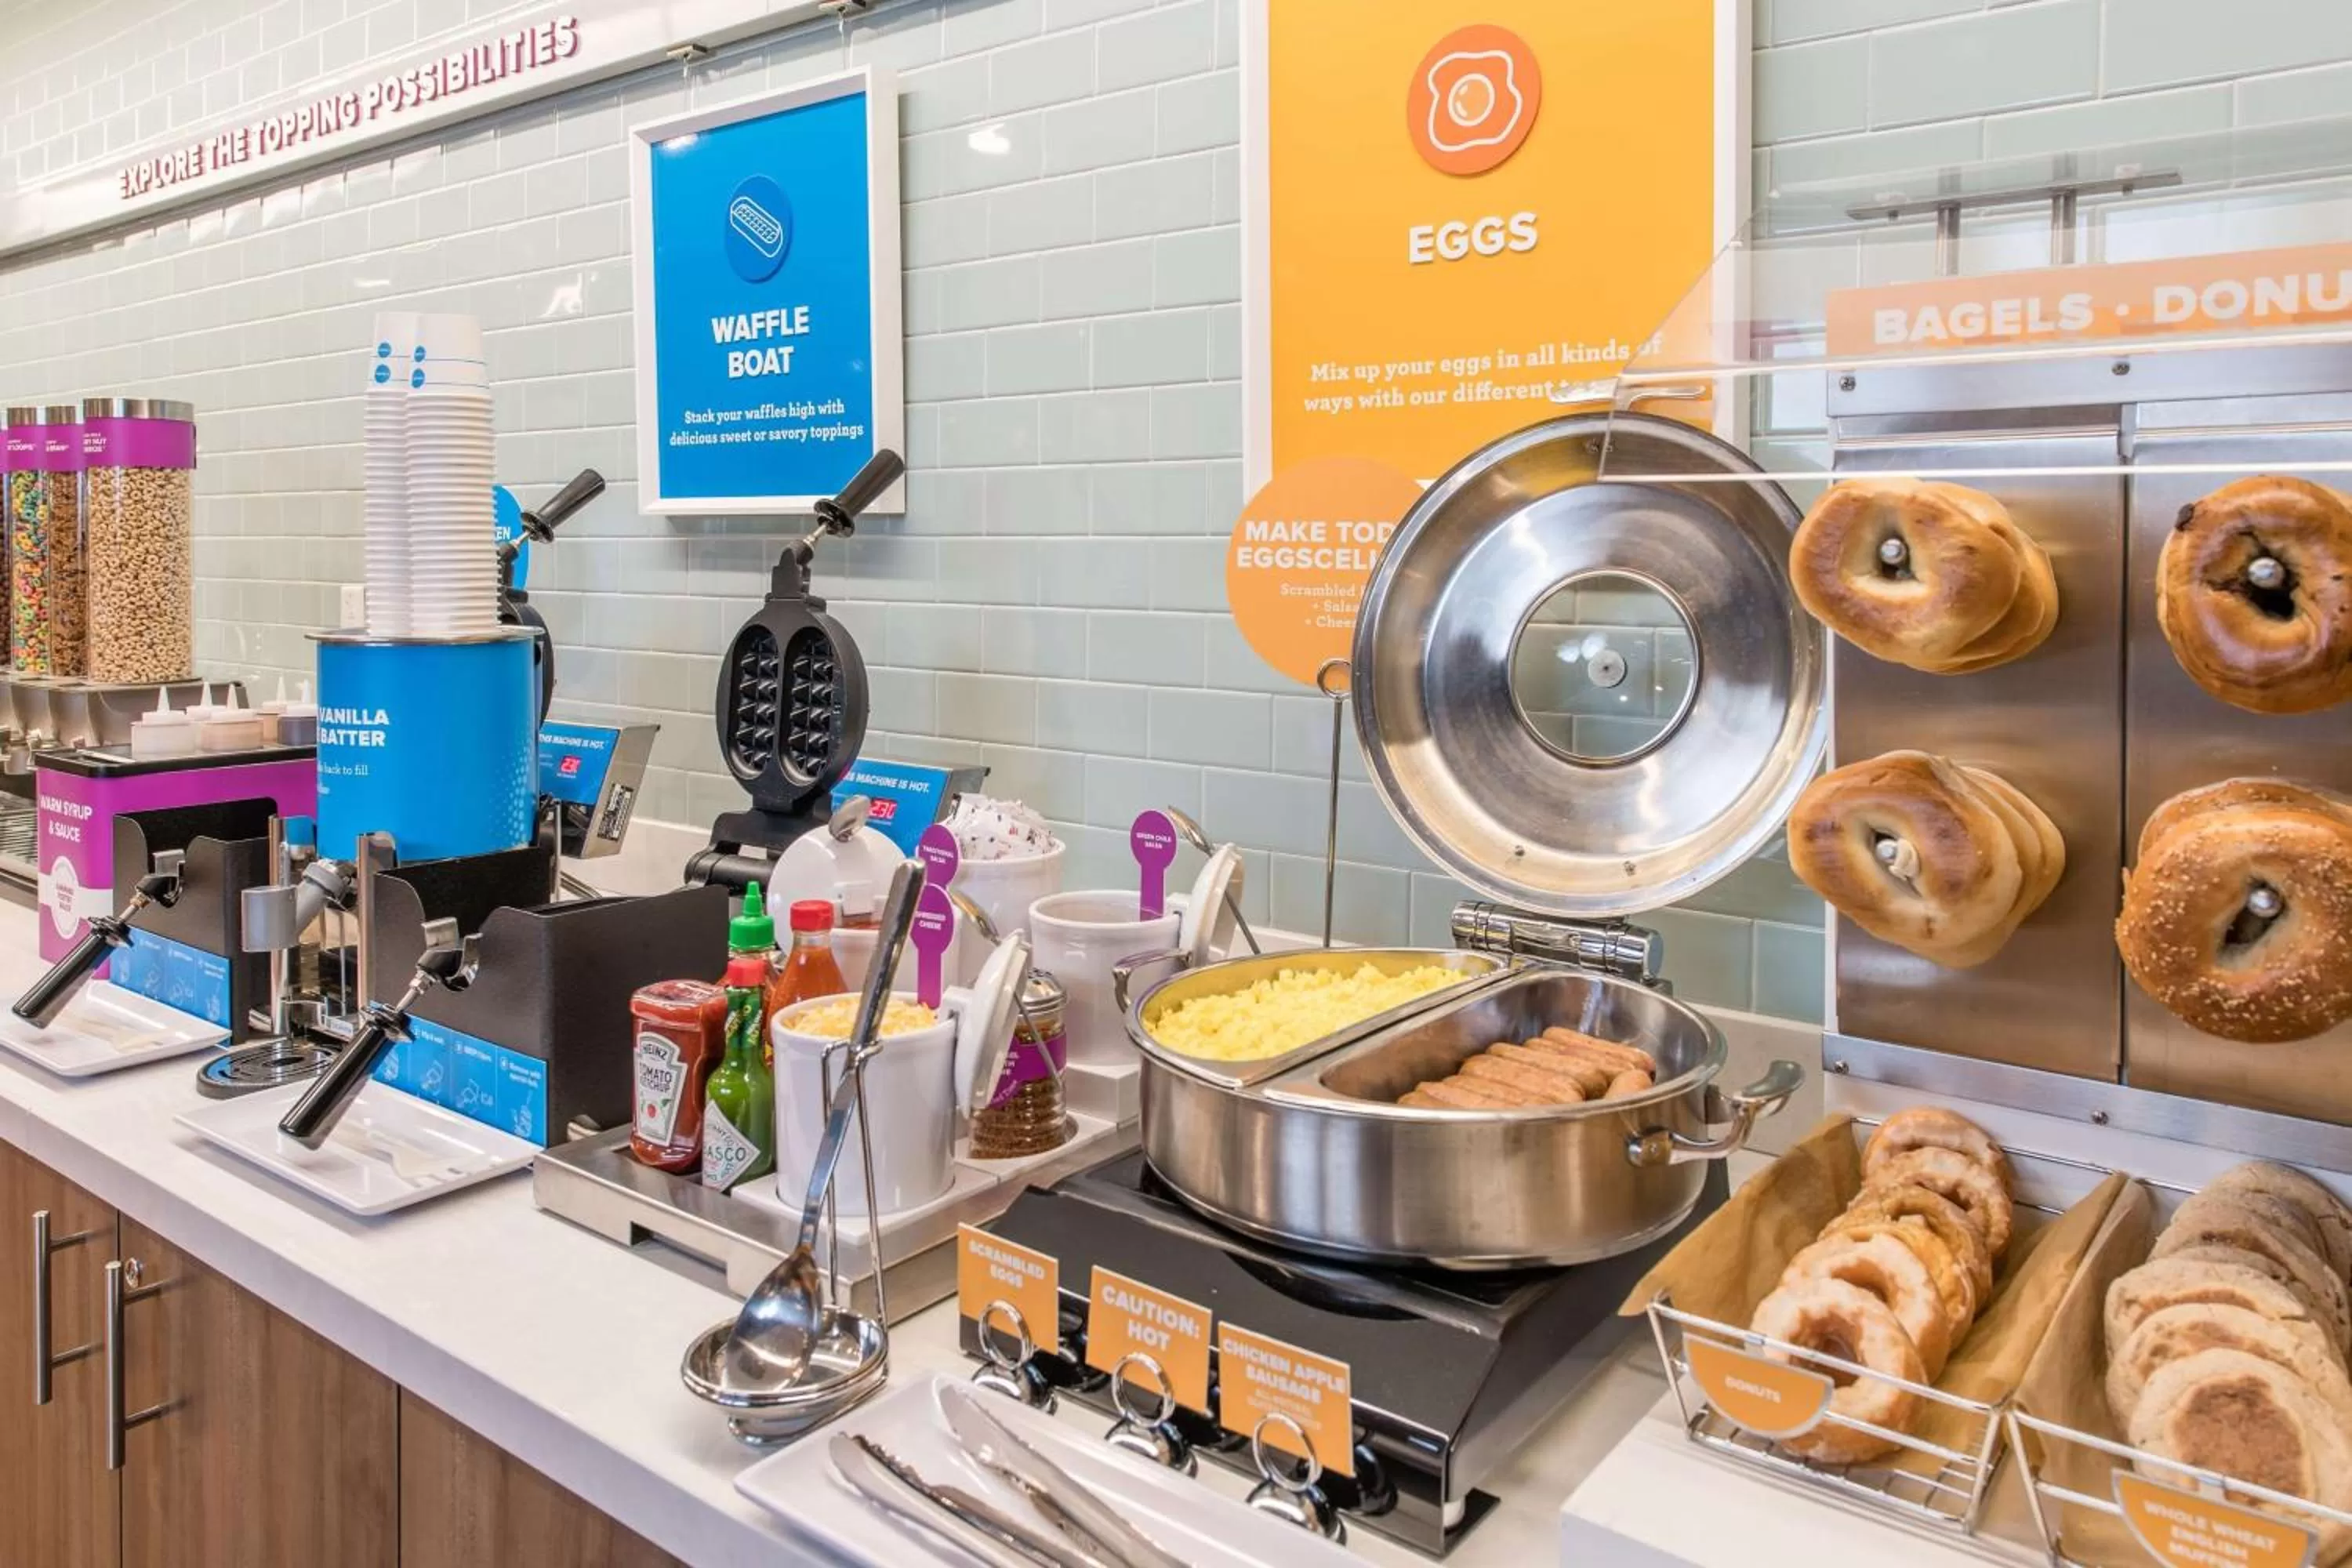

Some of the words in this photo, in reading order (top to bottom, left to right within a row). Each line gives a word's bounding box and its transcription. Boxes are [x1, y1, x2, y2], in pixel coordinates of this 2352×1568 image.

[119, 146, 204, 199] EXPLORE
[205, 126, 249, 169] THE
[251, 92, 361, 155] TOPPING
[364, 16, 579, 120] POSSIBILITIES
[1408, 211, 1537, 265] EGGS
[1875, 292, 2094, 344] BAGELS
[2152, 269, 2352, 325] DONU
[711, 306, 810, 343] WAFFLE
[728, 346, 794, 379] BOAT
[1310, 361, 1349, 382] Mix
[1355, 365, 1380, 383] up
[1385, 359, 1436, 381] your
[1440, 354, 1491, 376] eggs
[1497, 349, 1519, 368] in
[1526, 343, 1555, 365] all
[1561, 338, 1630, 364] kinds
[1637, 331, 1663, 356] of
[684, 408, 714, 423] Stack
[716, 409, 742, 425] your
[744, 403, 787, 420] waffles
[789, 401, 815, 419] high
[818, 398, 844, 415] with
[1304, 395, 1353, 414] ways
[1358, 389, 1405, 408] with
[1410, 389, 1447, 405] our
[1453, 381, 1555, 403] different
[670, 430, 717, 446] delicious
[719, 430, 752, 443] sweet
[753, 431, 767, 441] or
[768, 427, 808, 442] savory
[809, 422, 864, 441] toppings
[1245, 521, 1327, 542] MAKE
[1279, 583, 1356, 597] Scrambled
[320, 707, 390, 724] VANILLA
[321, 728, 387, 746] BATTER
[343, 766, 353, 775] to
[355, 764, 368, 775] fill
[856, 772, 898, 788] MACHINE
[898, 779, 908, 789] IS
[909, 781, 929, 793] HOT.
[40, 794, 62, 813] WARM
[63, 801, 93, 821] SYRUP
[55, 822, 81, 843] SAUCE
[643, 1044, 666, 1060] HEINZ
[706, 1145, 746, 1162] ASCO
[968, 1239, 1045, 1280] SCRAMBLED
[990, 1263, 1024, 1289] EGGS
[1102, 1284, 1200, 1339] CAUTION:
[1127, 1319, 1171, 1352] HOT
[1223, 1338, 1290, 1374] CHICKEN
[1294, 1363, 1346, 1393] APPLE
[1245, 1364, 1322, 1405] SAUSAGE
[1726, 1377, 1782, 1403] DONUTS
[2144, 1501, 2207, 1530] WHOLE
[2211, 1520, 2277, 1552] WHEAT
[2171, 1524, 2249, 1561] ENGLISH
